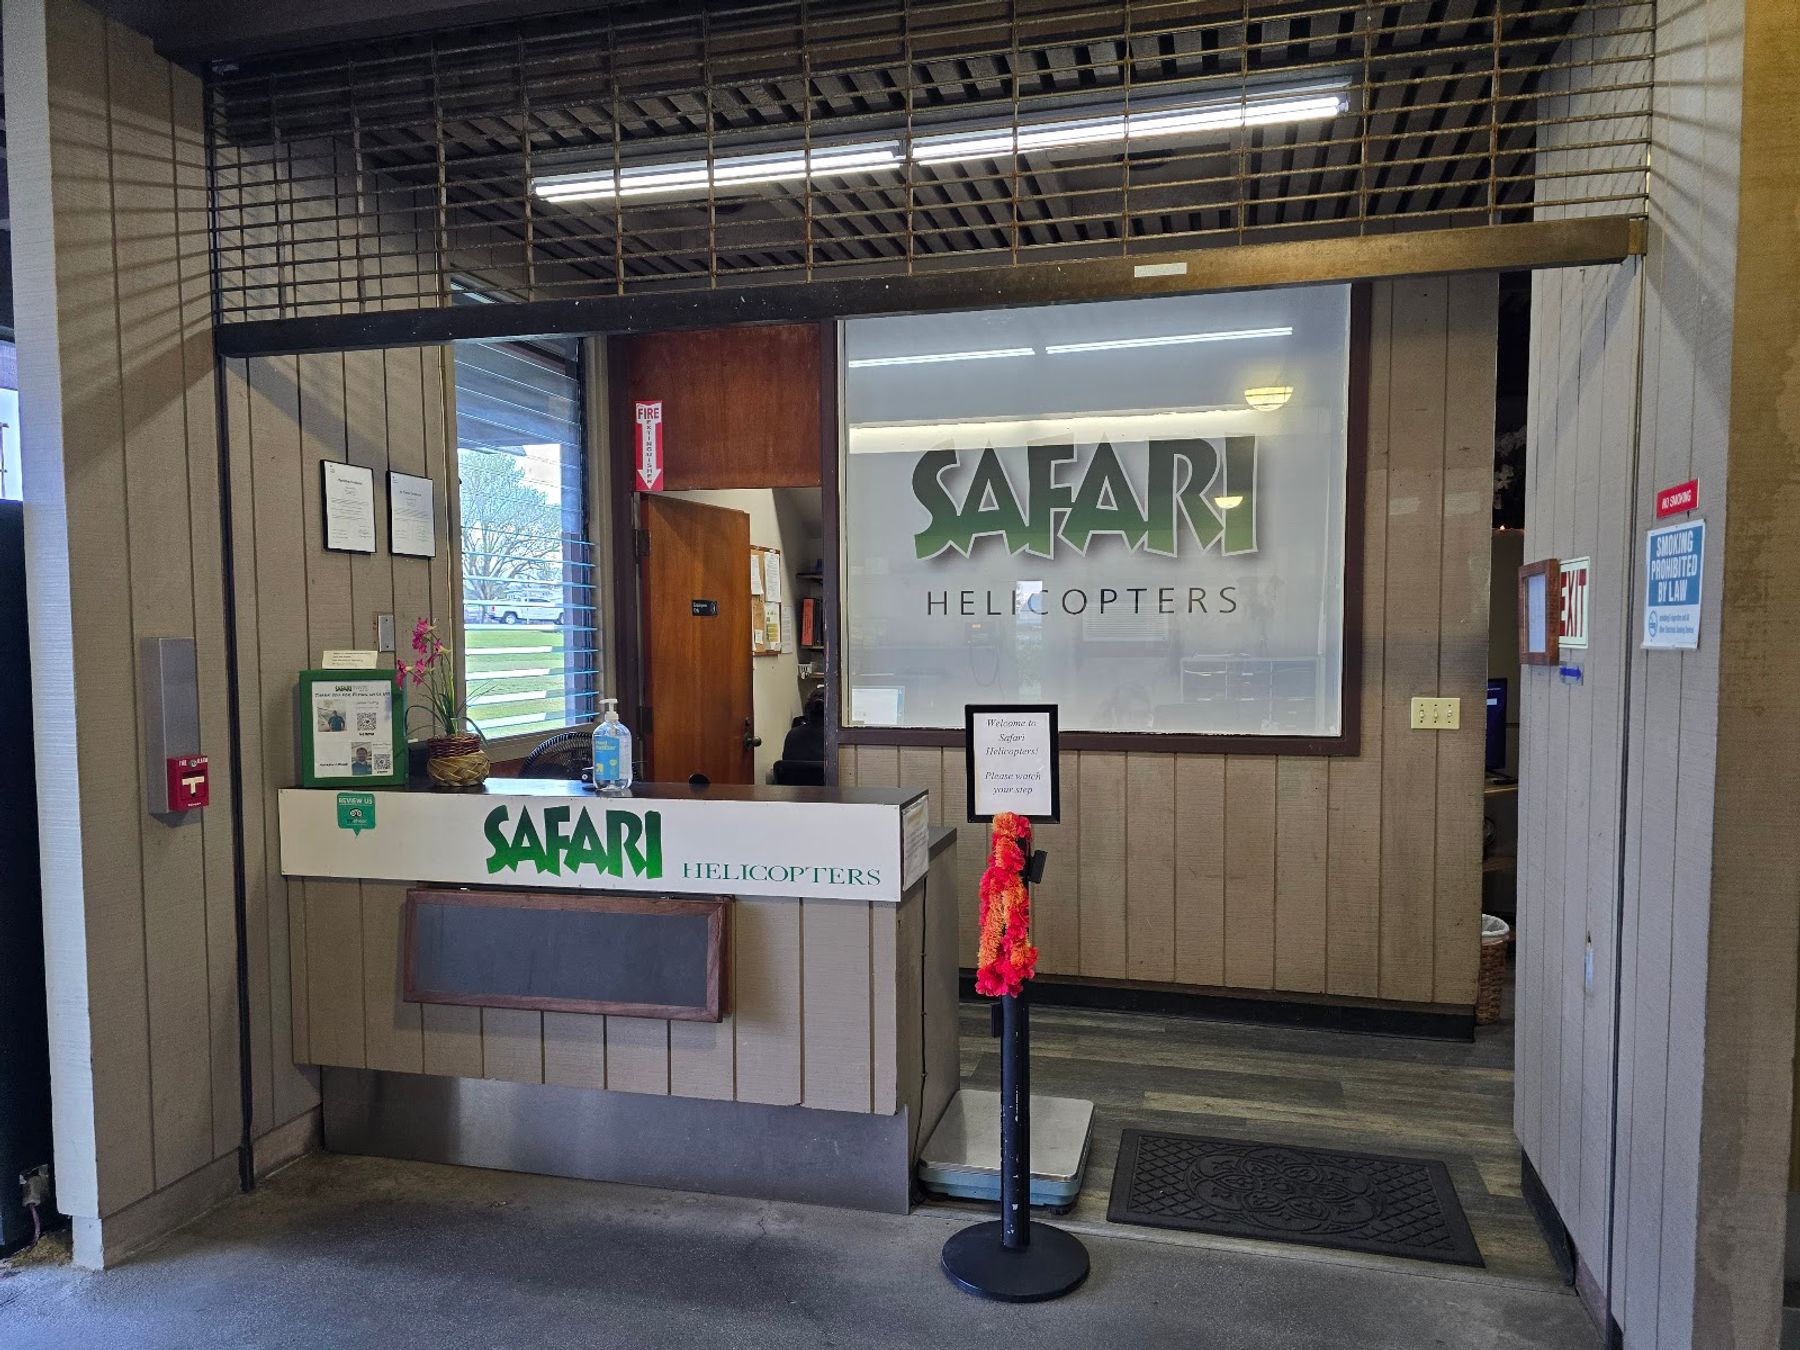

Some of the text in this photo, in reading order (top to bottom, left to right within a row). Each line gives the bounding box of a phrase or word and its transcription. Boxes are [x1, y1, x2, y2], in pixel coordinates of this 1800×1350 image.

[637, 407, 660, 419] FIRE
[645, 420, 653, 483] EXTINGUISHER
[912, 432, 1258, 560] SAFARI
[1661, 489, 1692, 510] NO SMOKING
[1656, 530, 1694, 558] SMOKING
[1651, 554, 1698, 581] PROHIBITED
[926, 586, 1238, 616] HELICOPTERS
[1657, 578, 1688, 603] BY LAW
[1559, 568, 1587, 638] EXIT
[987, 718, 1037, 727] Welcome to
[998, 733, 1026, 744] Safari
[985, 746, 1040, 757] Helicopters!
[985, 771, 1041, 781] Please watch
[363, 796, 373, 805] US
[993, 786, 1033, 795] your step
[483, 804, 882, 887] SAFARI HELICOPTERS
